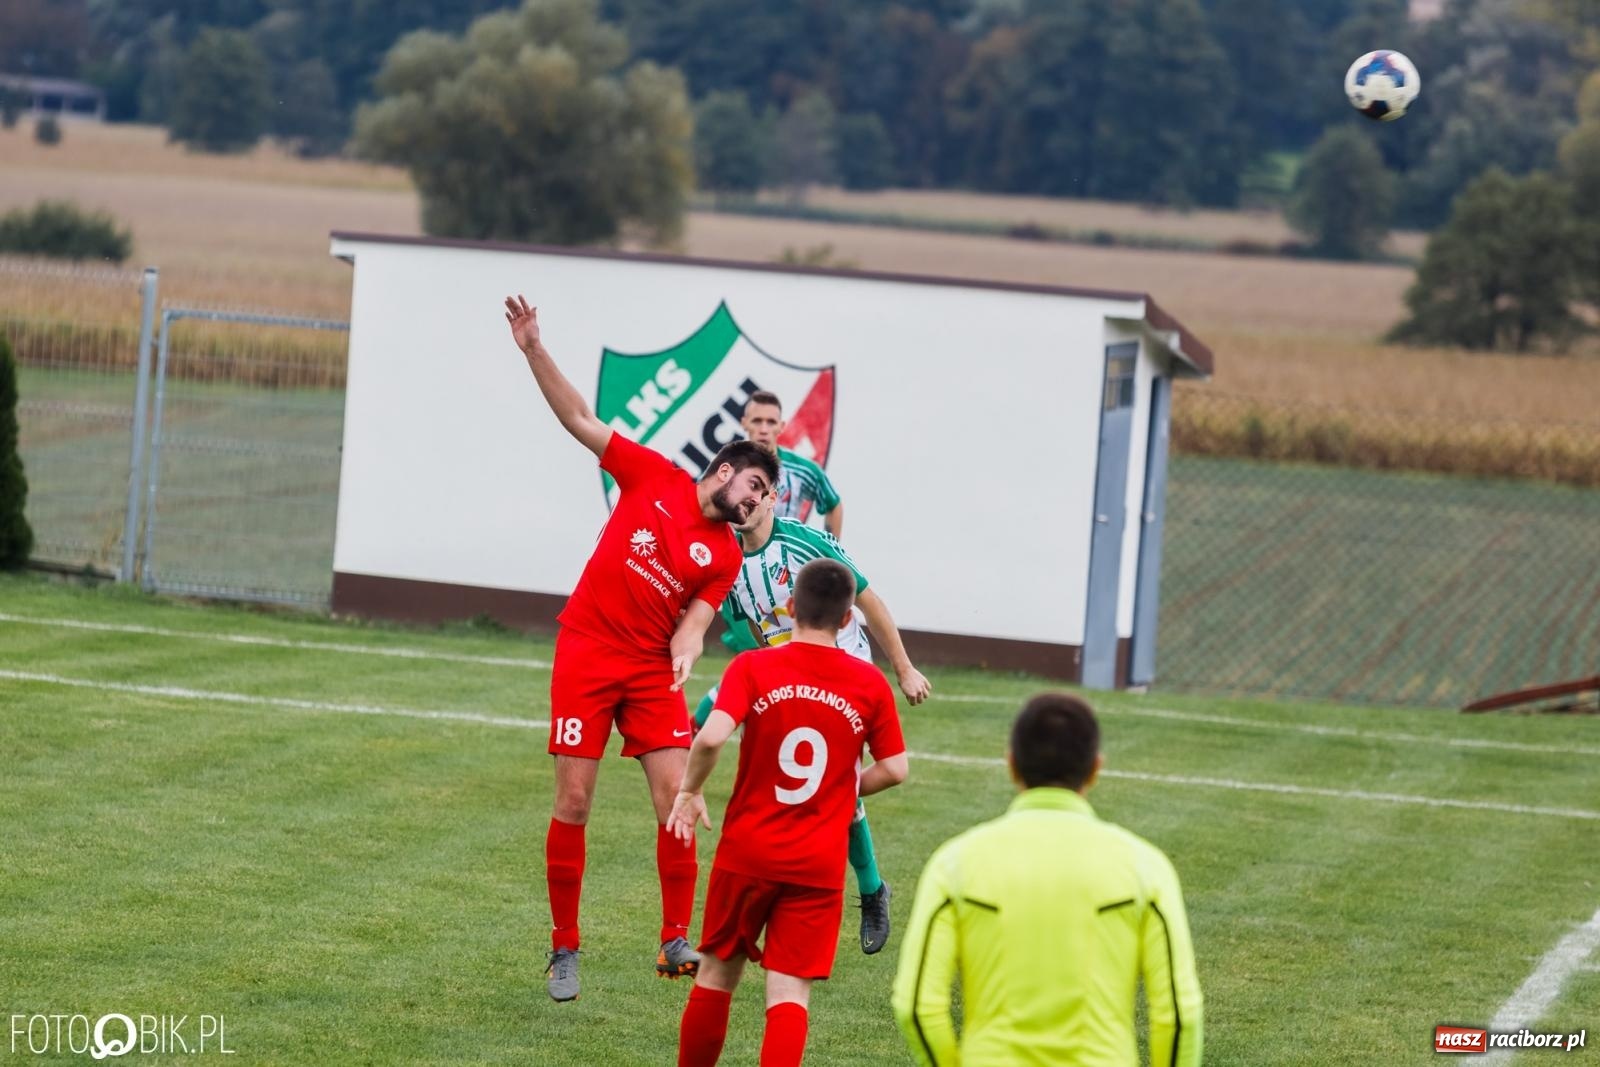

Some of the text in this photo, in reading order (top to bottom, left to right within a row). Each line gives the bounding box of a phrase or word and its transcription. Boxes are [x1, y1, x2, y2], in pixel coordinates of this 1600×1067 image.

[608, 358, 692, 445] LKS
[555, 717, 583, 746] 18
[752, 685, 864, 735] KS 1905 KRZANOWICE
[774, 726, 828, 805] 9
